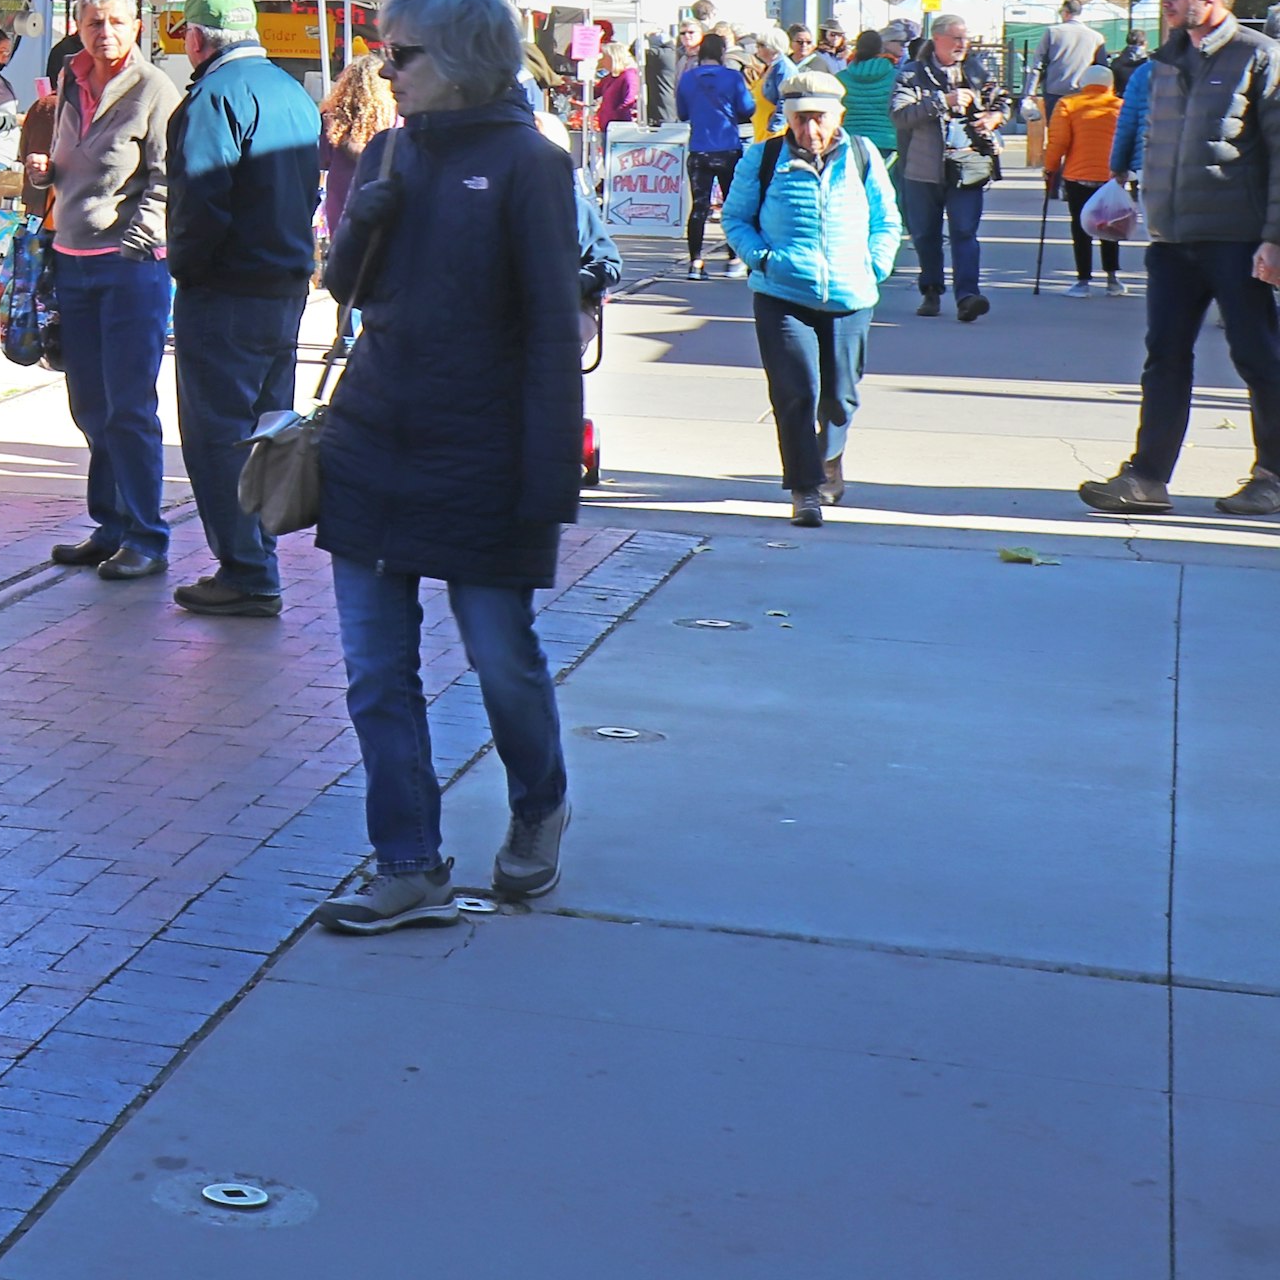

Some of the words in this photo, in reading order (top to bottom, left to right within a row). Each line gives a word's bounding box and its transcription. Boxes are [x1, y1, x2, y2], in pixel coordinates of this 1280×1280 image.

[262, 28, 297, 41] Cider
[616, 147, 680, 173] FRUIT
[612, 175, 680, 194] PAVILION
